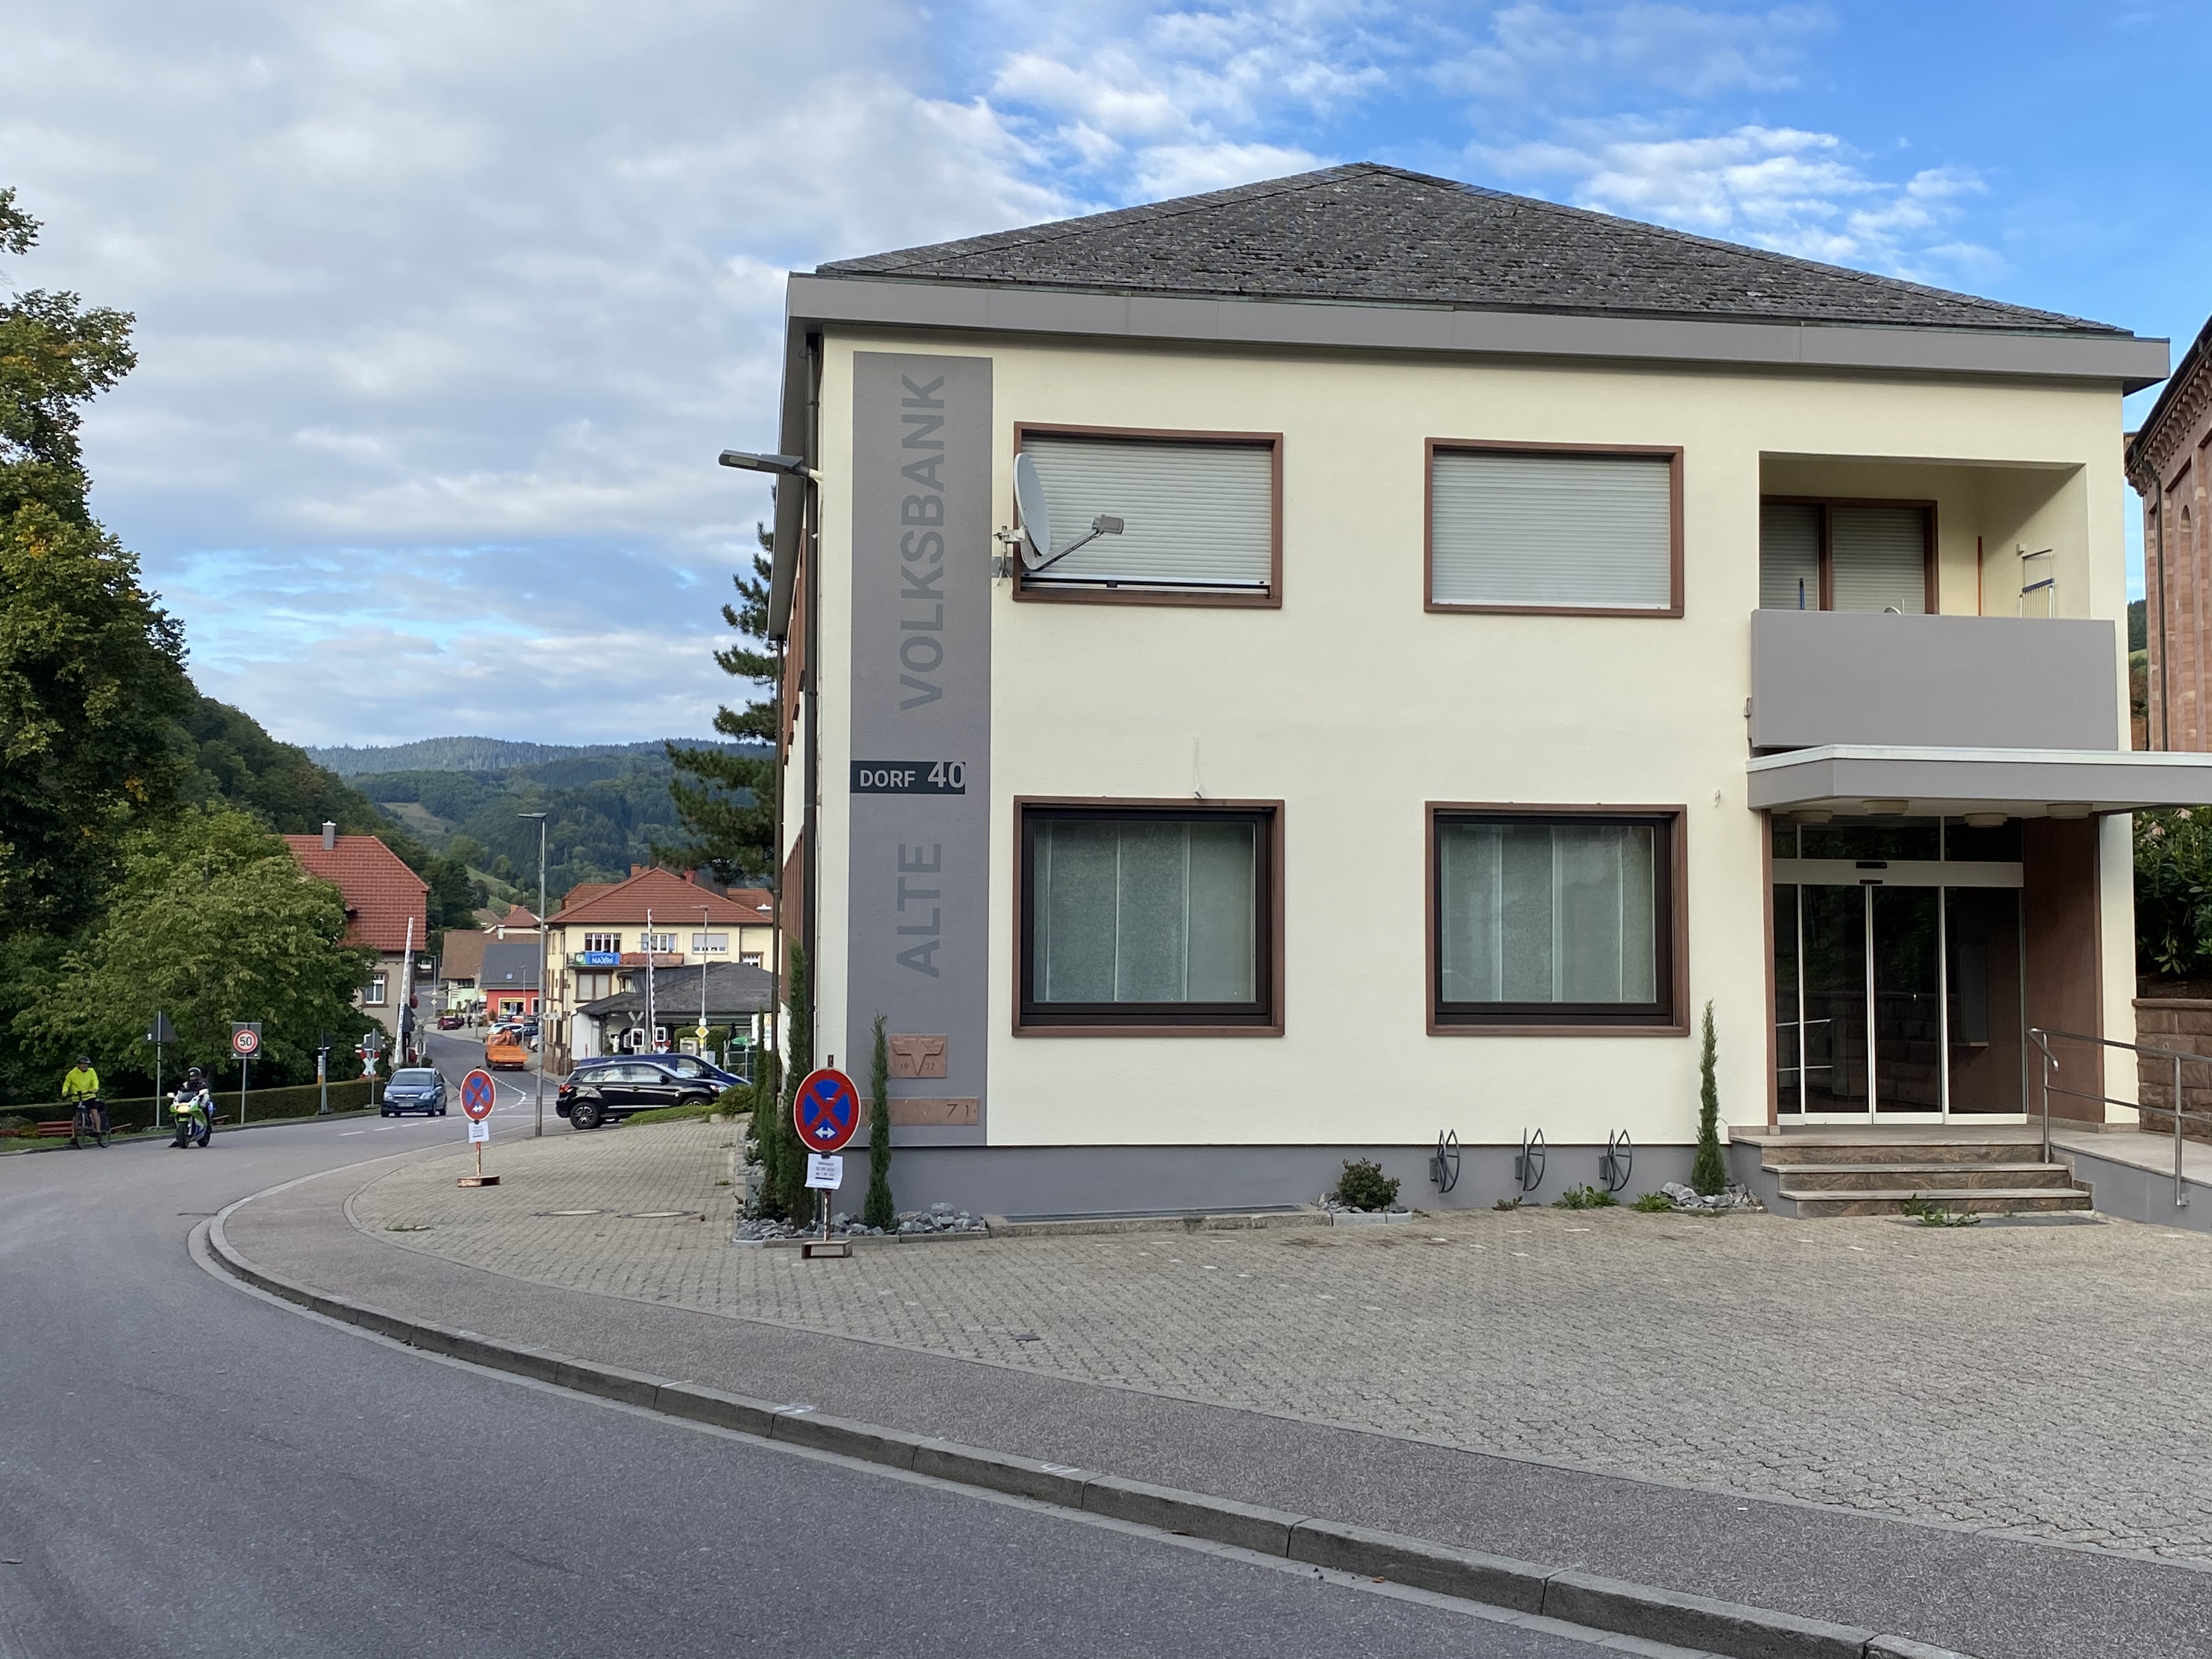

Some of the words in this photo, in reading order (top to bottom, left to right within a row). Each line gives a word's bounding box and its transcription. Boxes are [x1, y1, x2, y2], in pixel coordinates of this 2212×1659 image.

[900, 374, 944, 712] VOLKSBANK
[860, 770, 916, 787] DORF
[927, 760, 966, 788] 40
[896, 843, 941, 979] ALTE
[240, 1036, 252, 1046] 50
